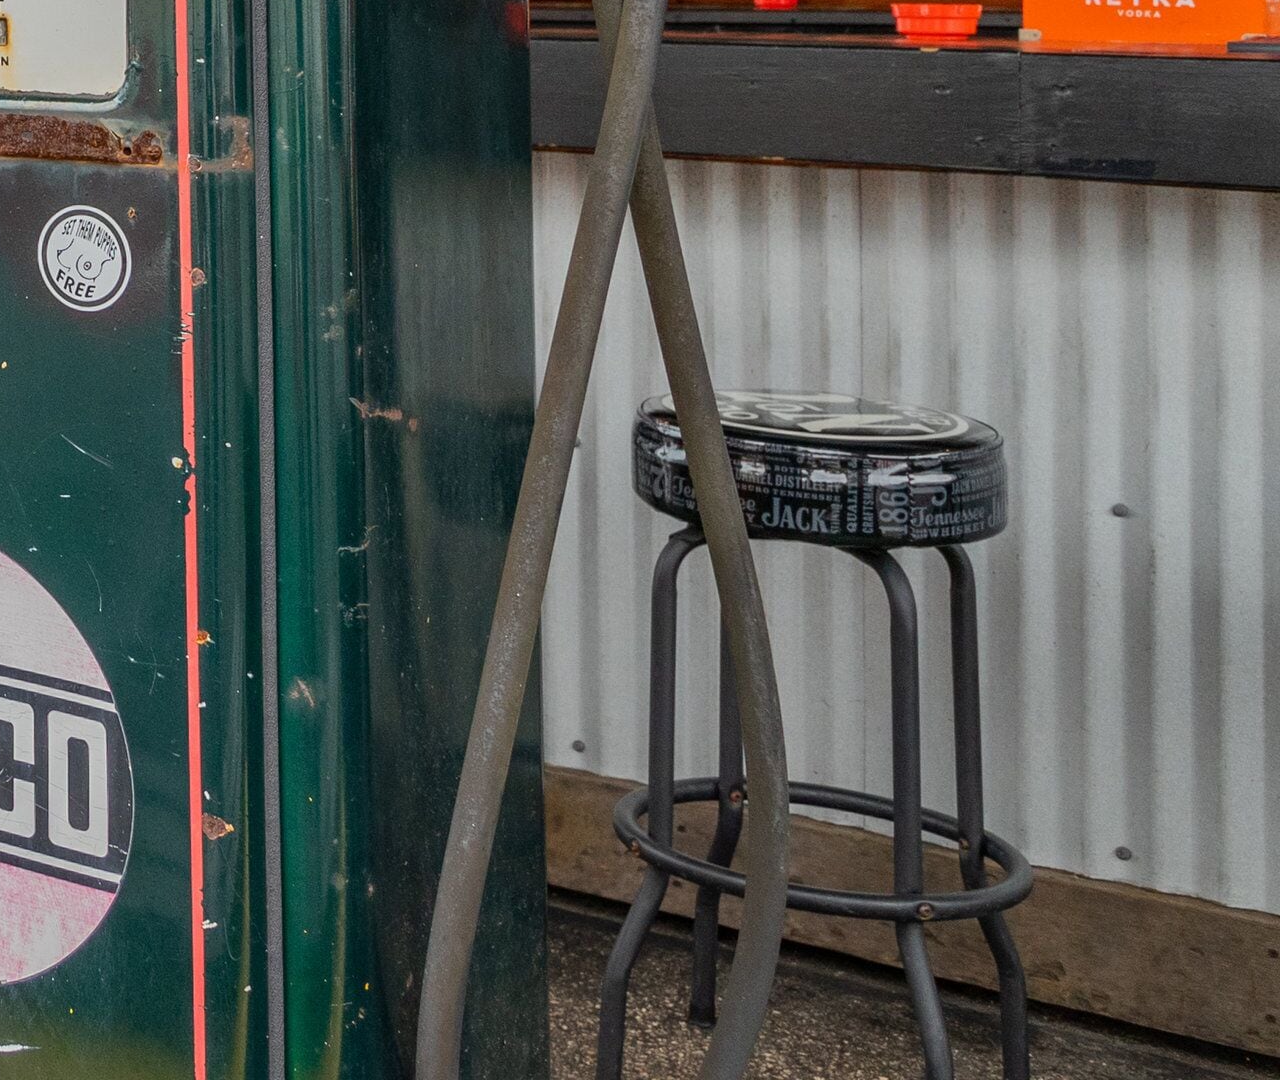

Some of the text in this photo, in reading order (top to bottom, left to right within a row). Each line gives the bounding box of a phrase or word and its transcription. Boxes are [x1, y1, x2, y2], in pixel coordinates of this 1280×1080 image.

[1117, 9, 1161, 18] VODKA
[62, 219, 117, 260] SET THEM PUPPIES
[56, 269, 96, 298] FREE
[772, 488, 840, 501] TENNESSEE
[846, 470, 858, 533] QUALITY
[761, 497, 828, 533] JACK
[910, 506, 985, 527] Tennessee
[928, 521, 985, 537] WHISKEY
